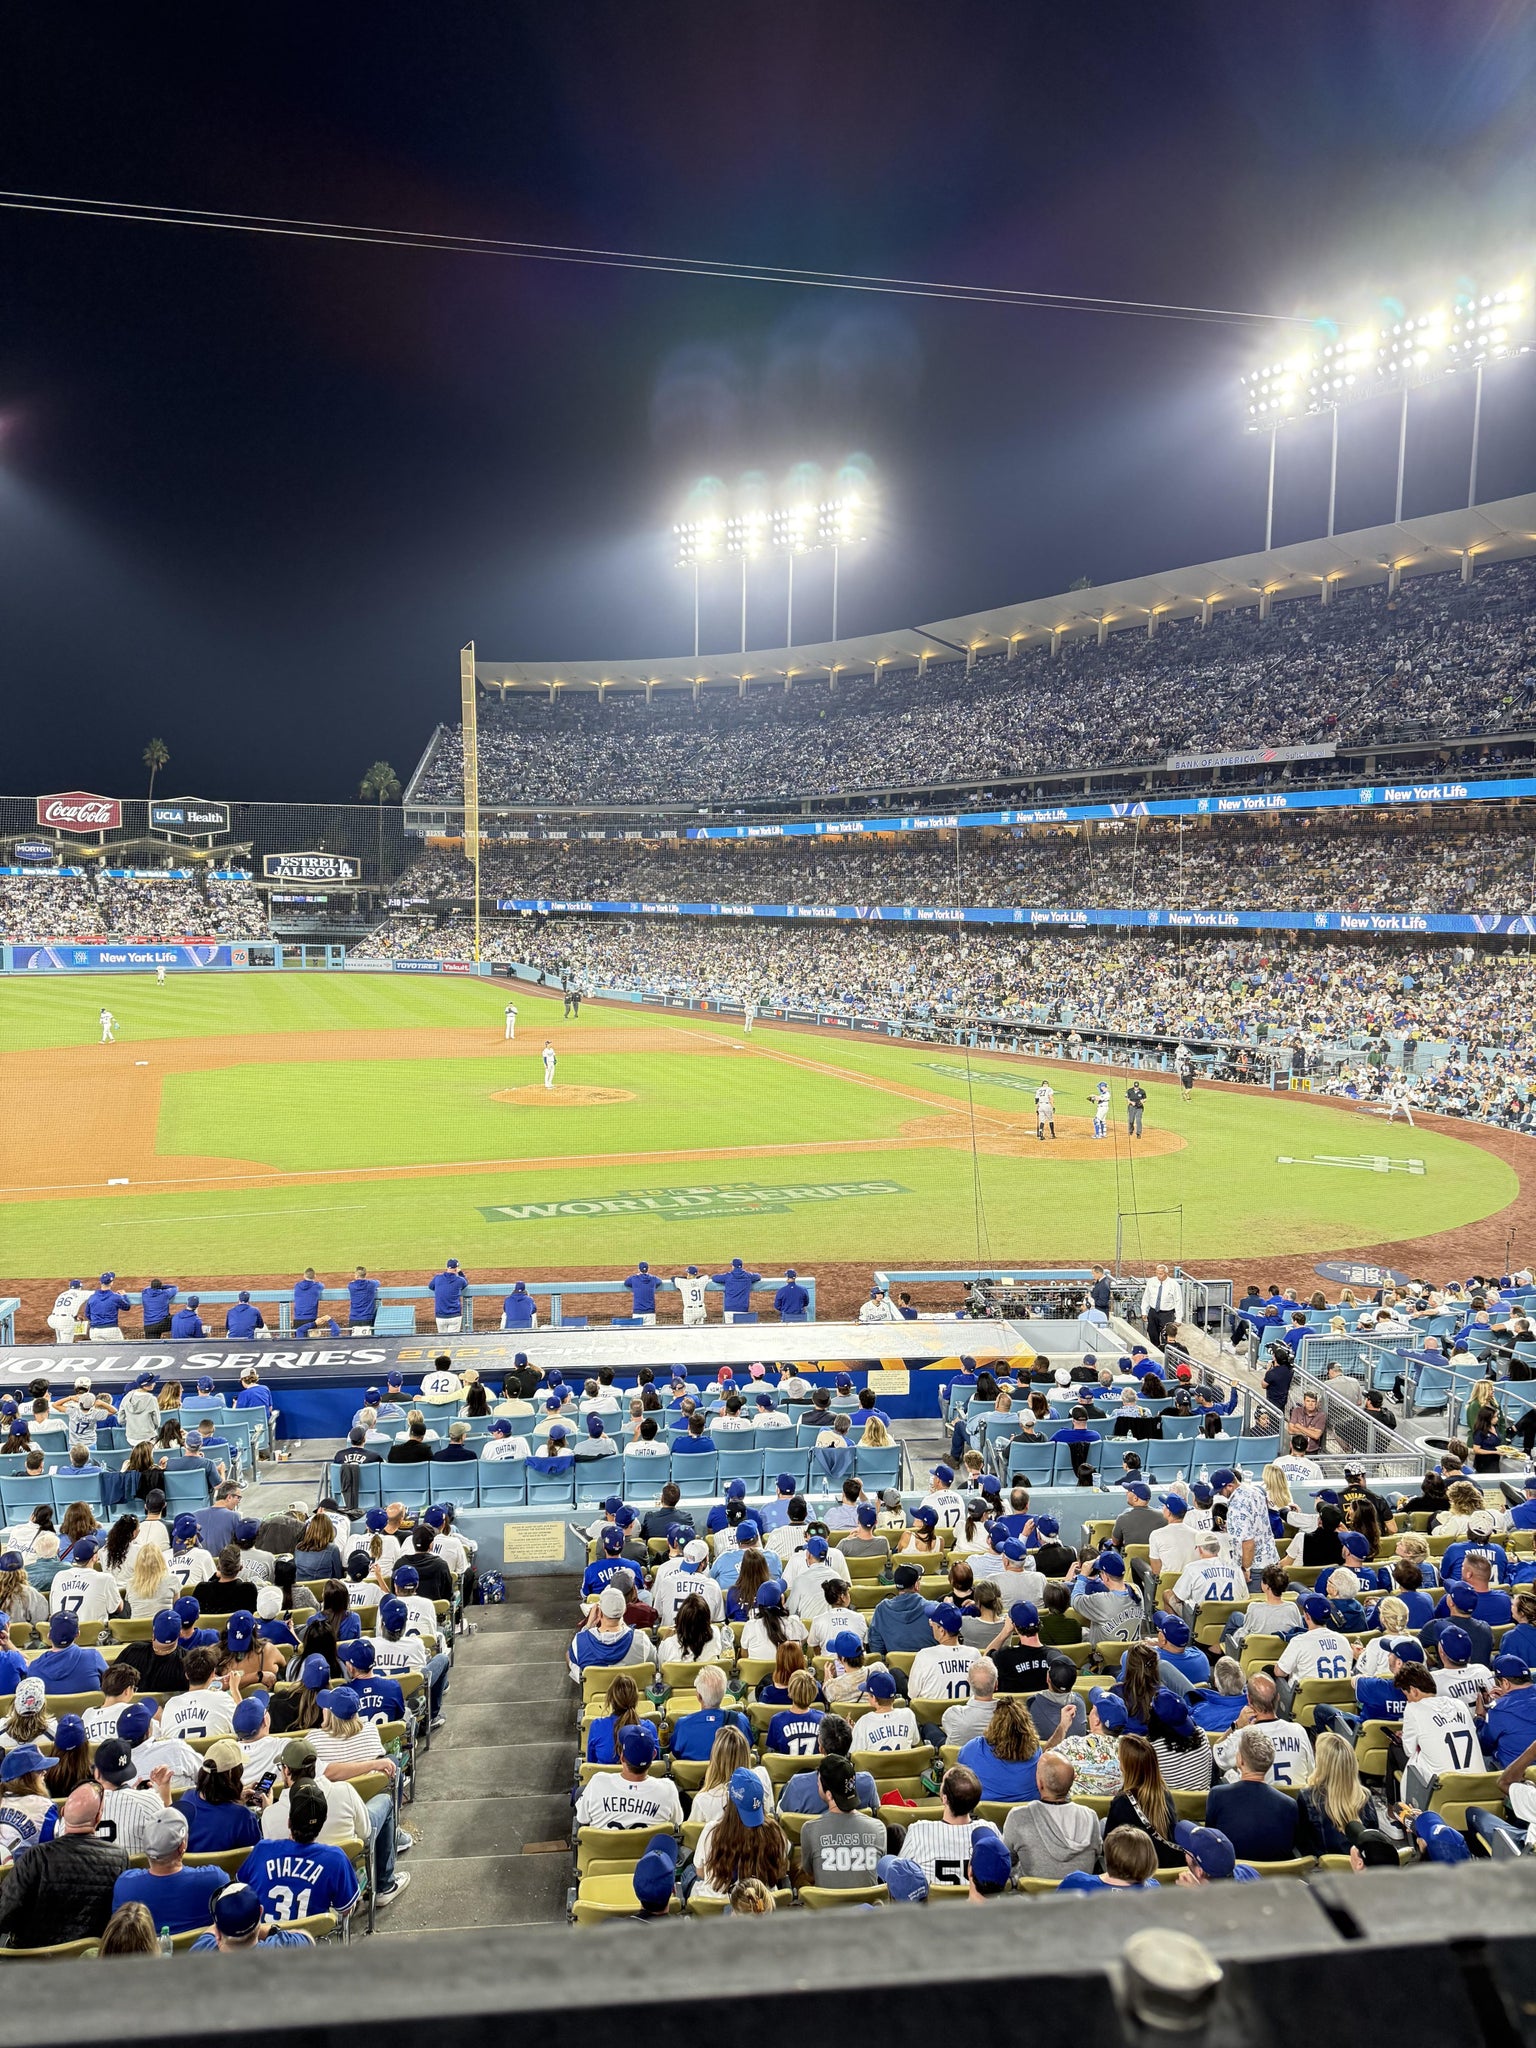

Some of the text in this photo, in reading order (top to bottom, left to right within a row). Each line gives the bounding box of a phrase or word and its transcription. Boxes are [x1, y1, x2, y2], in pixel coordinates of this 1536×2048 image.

[1175, 756, 1256, 769] BANK OF AMERICA
[1384, 785, 1468, 801] New York Life
[1218, 796, 1287, 810] New York Life
[46, 801, 114, 824] Coca-Cola
[155, 811, 223, 823] UCLA Health
[1016, 809, 1068, 822] New York Life
[826, 822, 864, 832] New York Life
[914, 815, 958, 828] New York Life
[748, 825, 783, 836] New York Life
[17, 845, 51, 853] MORTON
[273, 867, 336, 877] JALISCO
[642, 904, 679, 913] New York Life
[720, 906, 754, 915] New York Life
[798, 908, 837, 917] New York Life
[918, 909, 965, 920] New York Life
[1031, 911, 1087, 922] New York Life
[1168, 913, 1239, 925] New York Life
[1341, 915, 1427, 929] New York Life
[100, 953, 177, 962] New York Life
[235, 953, 245, 961] 76
[444, 963, 470, 971] Yakult
[493, 1182, 900, 1219] WORLD SERIES
[690, 1289, 702, 1302] 91
[0, 1355, 175, 1374] ORLD
[181, 1348, 387, 1371] SERIES
[430, 1379, 449, 1393] 42
[76, 1421, 91, 1435] 17
[495, 1444, 516, 1455] OHTANI
[343, 1453, 367, 1464] JETER
[886, 1520, 904, 1529] 17
[944, 1508, 960, 1528] 17
[1197, 1518, 1213, 1530] BET
[168, 1556, 194, 1567] OHTANI
[170, 1570, 190, 1586] 7
[1200, 1567, 1235, 1580] WOOTTON
[61, 1581, 90, 1592] OHTANI
[676, 1581, 705, 1595] BETTS
[1204, 1582, 1235, 1601] 44
[60, 1595, 84, 1612] 17
[1319, 1638, 1338, 1651] PUIG
[938, 1659, 972, 1675] TURNE
[1015, 1660, 1040, 1674] SHE IS
[1316, 1655, 1347, 1679] 66
[946, 1680, 970, 1700] 10
[1448, 1679, 1484, 1699] OHTAN
[357, 1695, 384, 1711] ETTS
[175, 1708, 209, 1724] OHTANI
[1432, 1712, 1466, 1727] OHANI
[84, 1721, 116, 1740] BETTS
[783, 1721, 820, 1738] OHTANI
[868, 1724, 909, 1744] BUEHLER
[787, 1737, 817, 1755] 17
[1272, 1736, 1300, 1753] EMAN
[1444, 1730, 1473, 1770] 17
[603, 1796, 661, 1818] KERSHAW
[0, 1807, 38, 1841] NGELES
[820, 1833, 877, 1847] CLASS OF
[820, 1846, 877, 1871] 2026
[266, 1857, 324, 1885] PIAZZA
[934, 1860, 970, 1886] 5
[264, 1885, 312, 1923] 31
